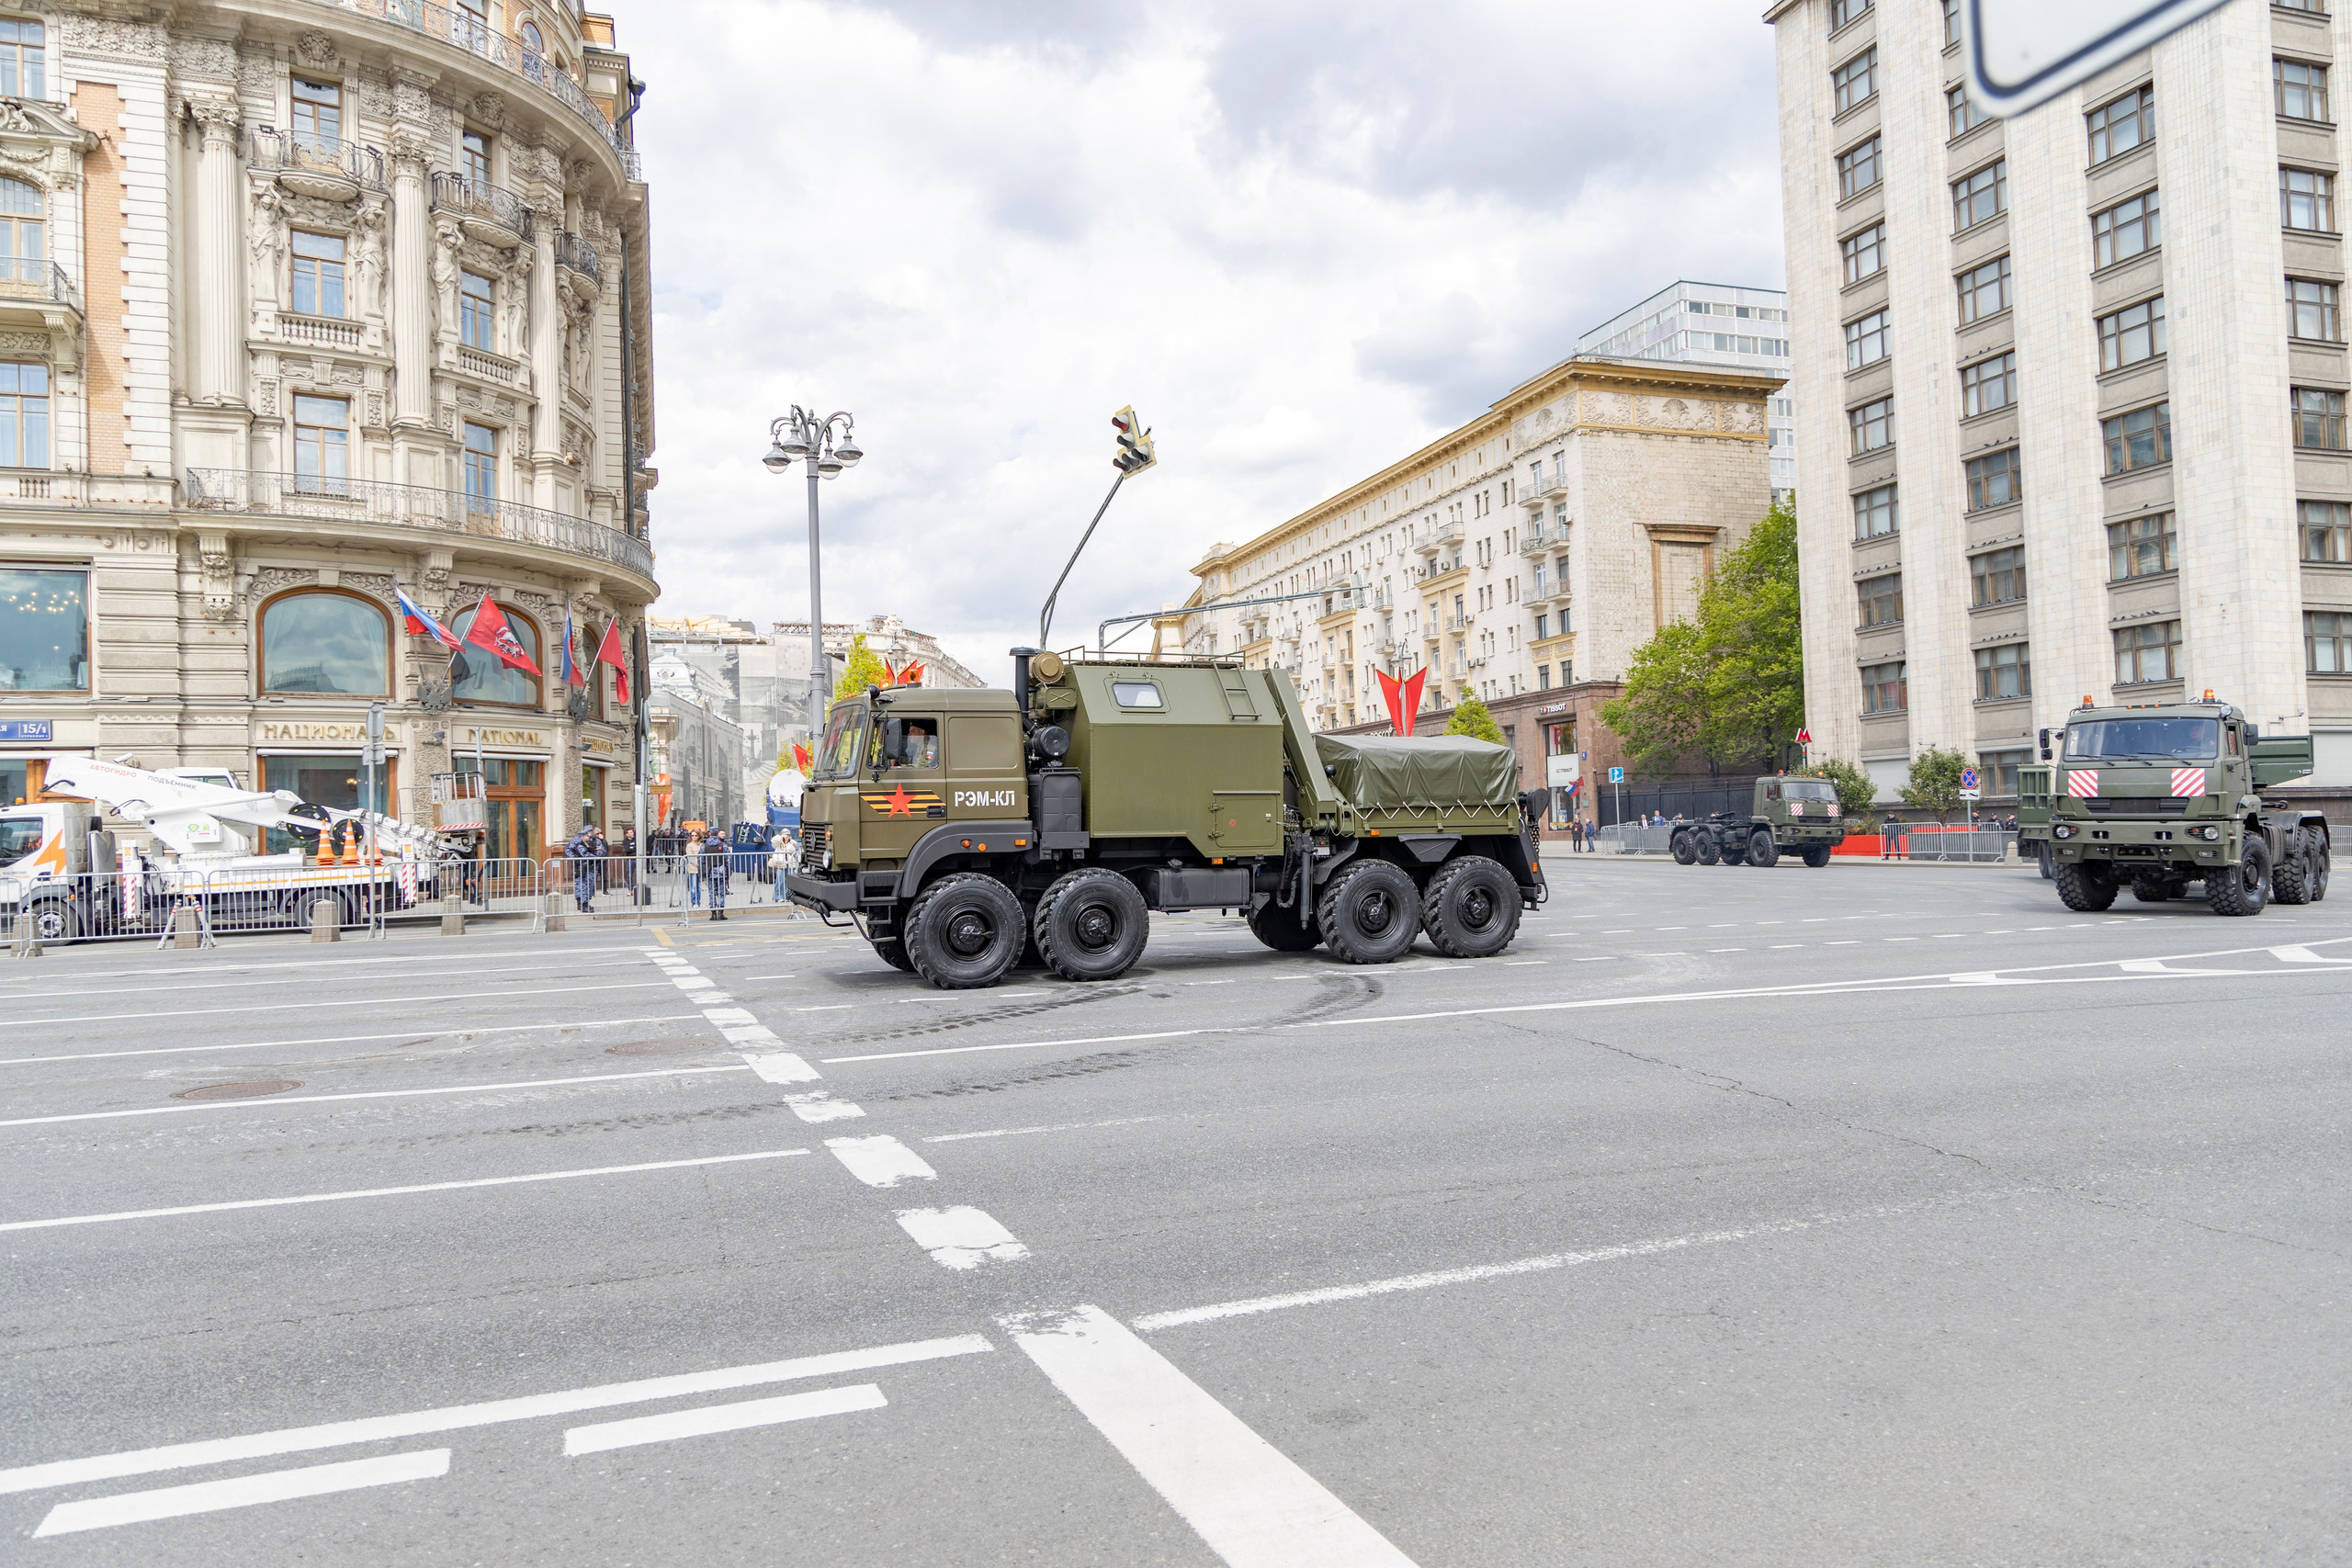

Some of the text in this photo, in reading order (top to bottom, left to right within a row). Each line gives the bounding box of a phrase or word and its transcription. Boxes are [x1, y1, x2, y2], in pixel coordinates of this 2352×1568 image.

[1547, 703, 1566, 713] TISSOT
[22, 723, 47, 734] 15/1
[264, 724, 396, 740] НАЦИОНАЬ
[90, 764, 137, 778] АВТОГИДРО
[147, 775, 197, 790] ПОДЪЕМНИК
[954, 790, 1015, 807] РЭМ-КЛ
